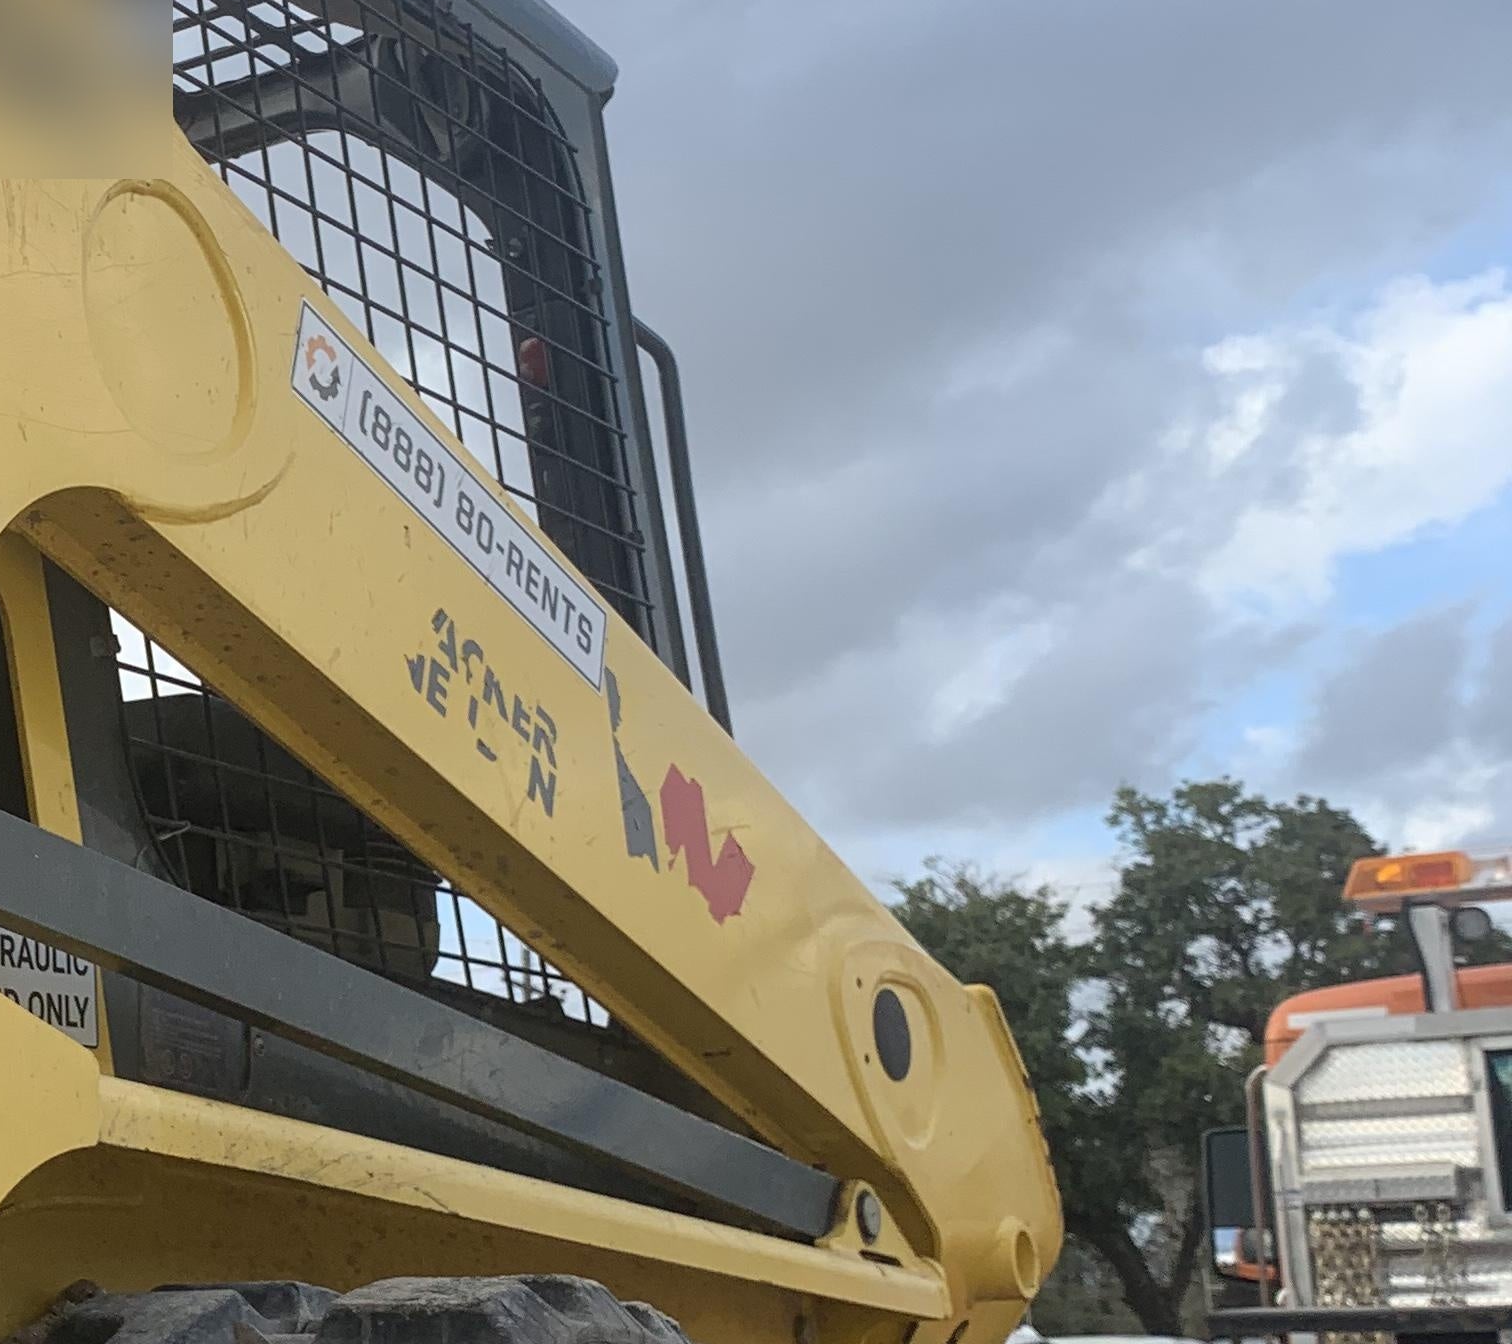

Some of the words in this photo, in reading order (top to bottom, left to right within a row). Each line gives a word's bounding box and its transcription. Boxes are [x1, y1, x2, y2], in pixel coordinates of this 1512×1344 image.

[359, 389, 445, 509] (888)
[455, 490, 593, 655] 80-RENTS
[29, 991, 89, 1029] ONLY
